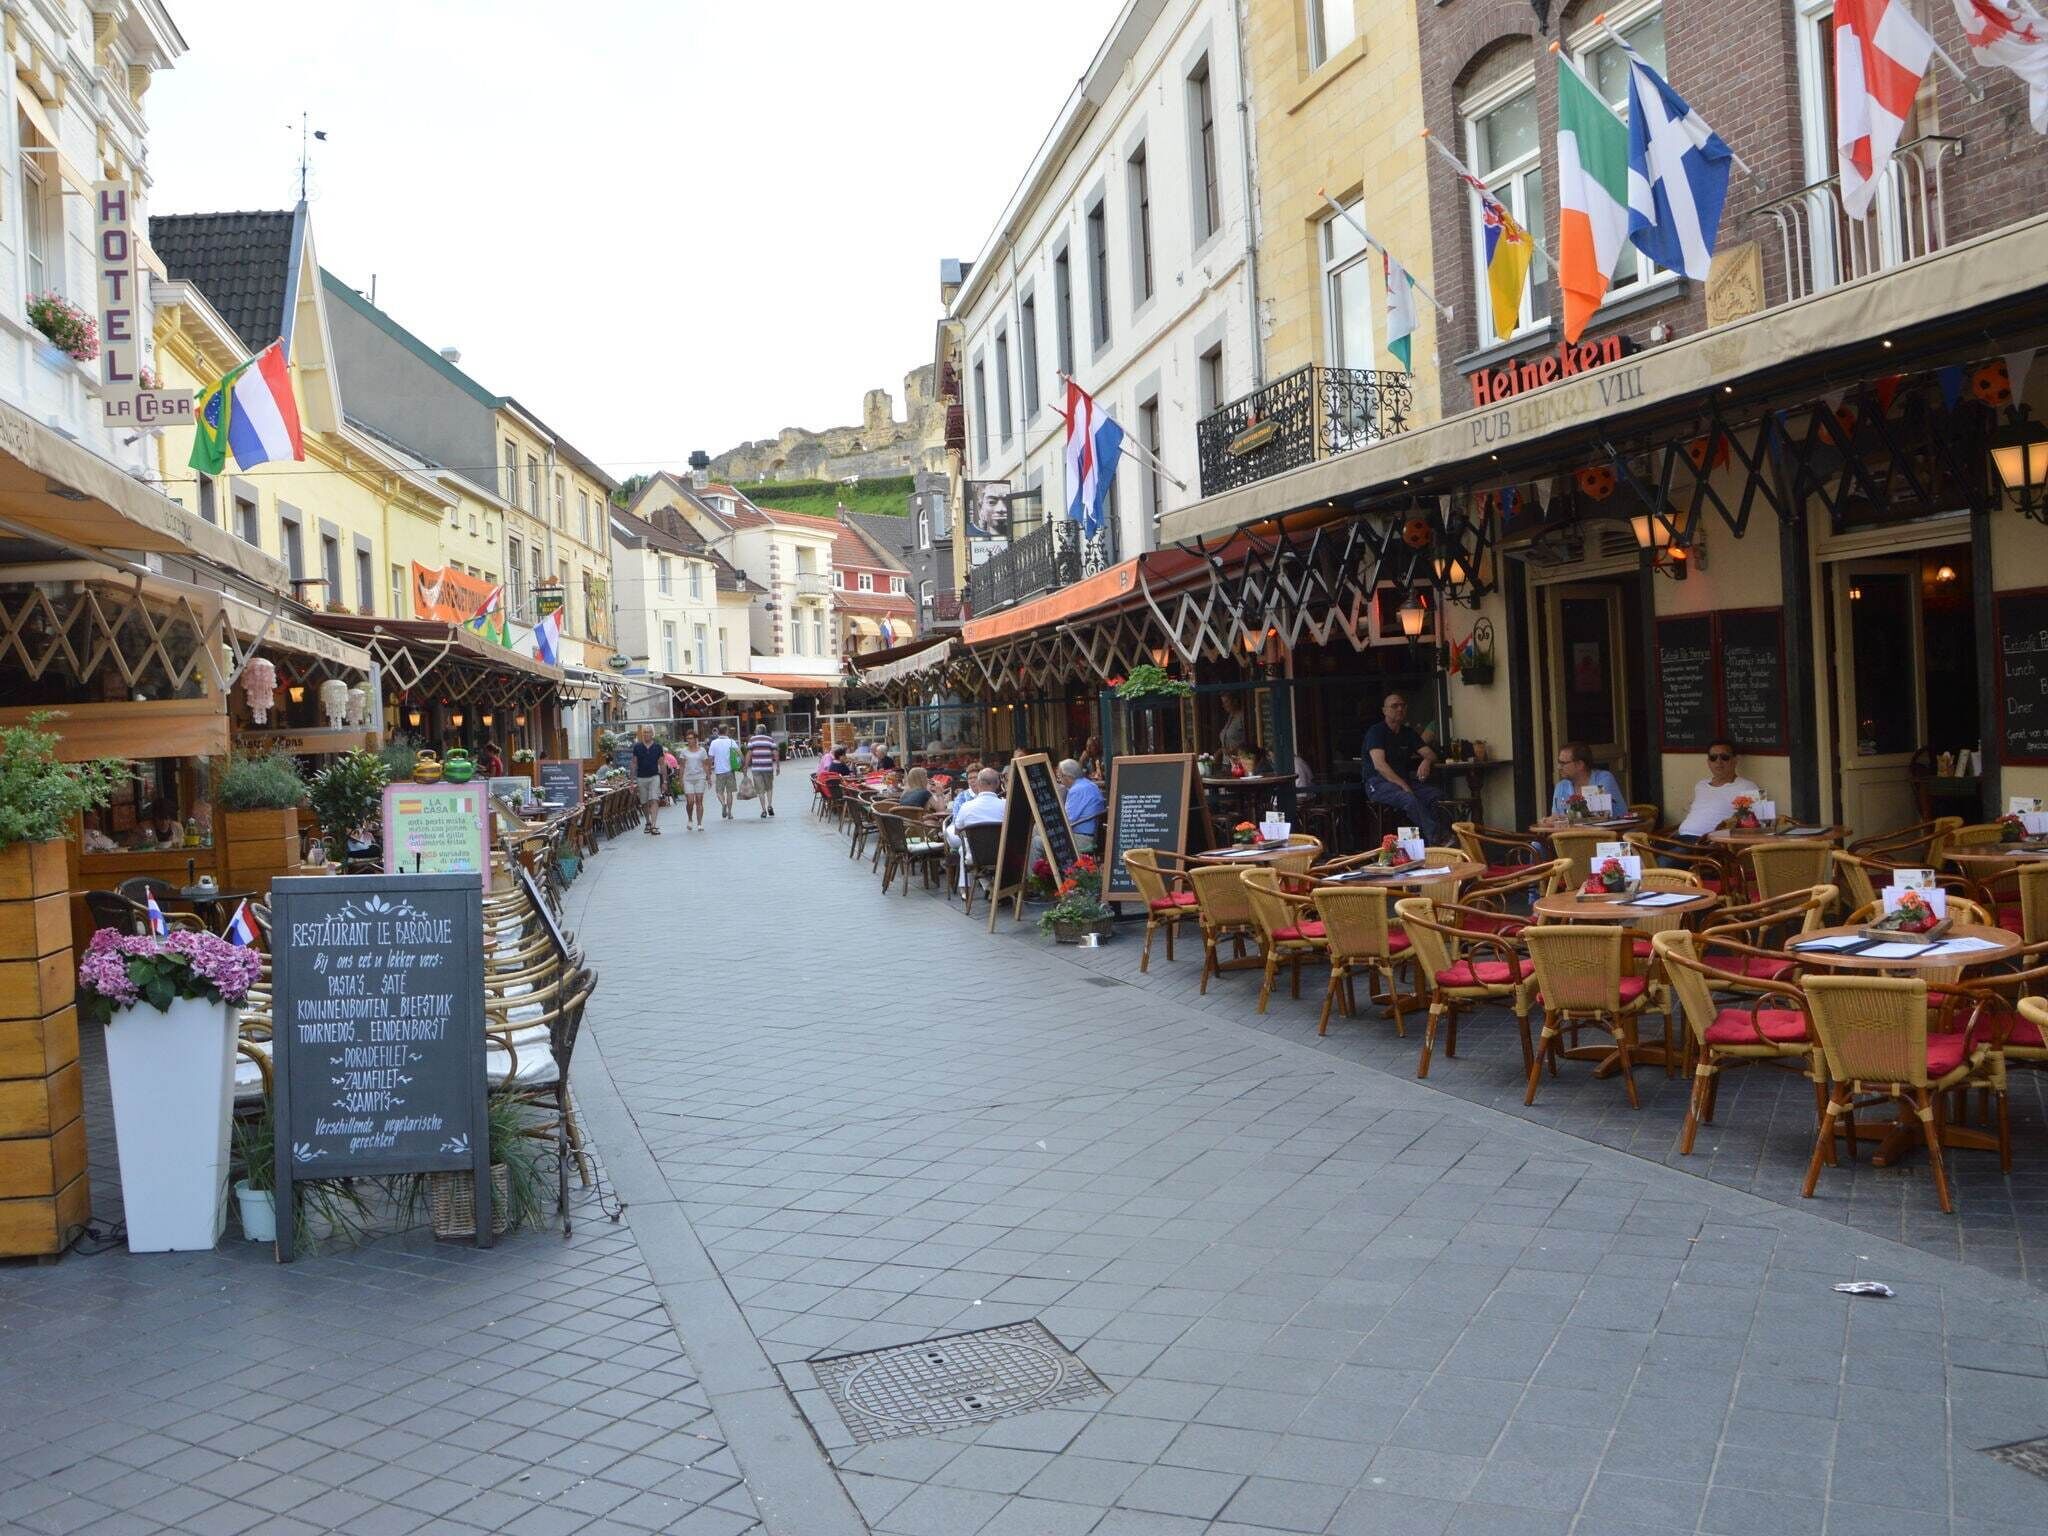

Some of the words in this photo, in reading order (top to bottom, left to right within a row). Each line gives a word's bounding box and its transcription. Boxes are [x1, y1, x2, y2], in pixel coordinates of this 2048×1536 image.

[102, 189, 134, 382] HOTEL
[1471, 335, 1623, 408] Heineken
[106, 401, 131, 416] LA
[136, 393, 191, 422] CASA
[1471, 410, 1512, 448] PUB
[1517, 382, 1593, 434] HENRY
[1598, 366, 1645, 408] VIII
[423, 805, 449, 814] CASA
[292, 921, 371, 947] RESTAURANT
[377, 922, 391, 945] LE
[395, 919, 452, 945] BAROQUE
[313, 952, 329, 974] Bij
[336, 954, 353, 968] ons
[358, 952, 372, 968] eet
[374, 956, 382, 968] u
[387, 949, 415, 968] lekker
[419, 953, 443, 968] vers:
[328, 973, 365, 996] PASTA'S
[298, 998, 388, 1019] KONIJNENBOUTEN
[400, 994, 454, 1017] BIEFSTUK
[298, 1019, 355, 1043] TOURNEDOS
[370, 1018, 448, 1041] EENDENBORST
[344, 1045, 408, 1067] DORADEFILET
[342, 1069, 400, 1090] ZALMFILET
[346, 1091, 391, 1112] SCAMPI'S
[315, 1117, 374, 1136] Verschillende
[384, 1113, 443, 1135] vegetarische
[350, 1132, 396, 1154] gerechten
